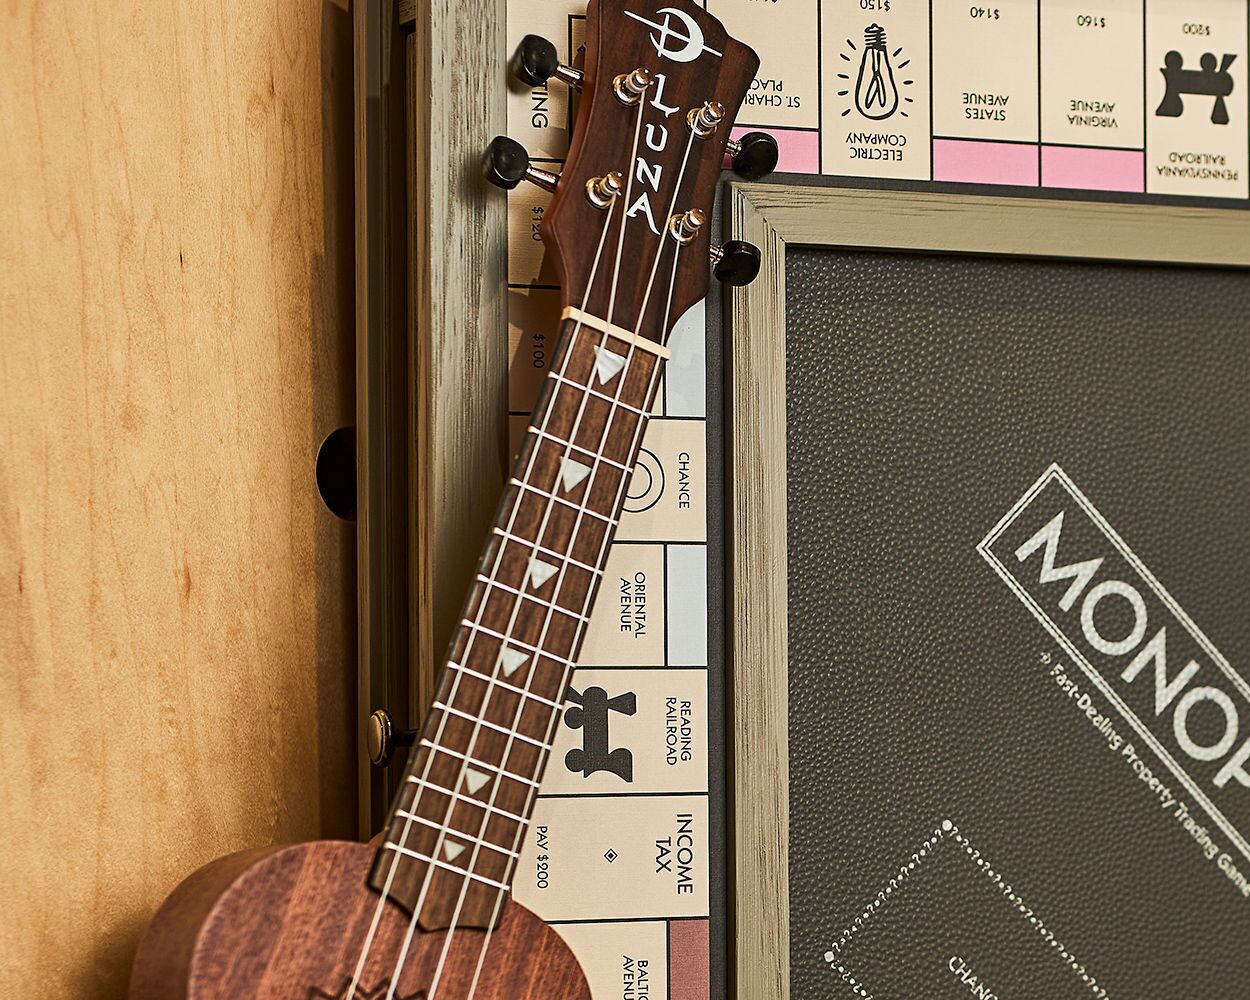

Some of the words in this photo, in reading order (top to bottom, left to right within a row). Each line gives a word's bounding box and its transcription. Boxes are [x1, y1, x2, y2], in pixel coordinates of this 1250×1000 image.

[970, 6, 1000, 19] $140
[1077, 15, 1105, 28] $160
[1182, 23, 1211, 36] $200
[750, 79, 783, 91] PLAC
[745, 94, 782, 106] CHAR
[786, 96, 801, 108] ST.
[963, 92, 1009, 106] AVENUE
[1070, 99, 1115, 113] AVENUE
[965, 107, 1006, 121] STATES
[1068, 114, 1118, 128] VIRGINIA
[845, 134, 907, 147] COMPANY
[626, 73, 680, 236] LUNA
[849, 147, 903, 161] ELECTRIC
[1168, 151, 1226, 166] RAILROAD
[1156, 165, 1239, 182] PENNSYLVANIA
[531, 206, 545, 243] $120
[533, 334, 545, 369] $100
[677, 451, 690, 510] CHANCE
[620, 577, 632, 633] AVENUE
[633, 571, 648, 639] ORIENTAL
[665, 696, 678, 767] RAILROAD
[679, 700, 692, 762] READING
[1049, 663, 1124, 751] Fast-Dealing
[1122, 744, 1176, 808] Property
[1174, 802, 1219, 859] Trading
[536, 825, 548, 851] PAY
[655, 836, 672, 874] TAX
[676, 813, 694, 896] INCOME
[536, 853, 548, 890] $200
